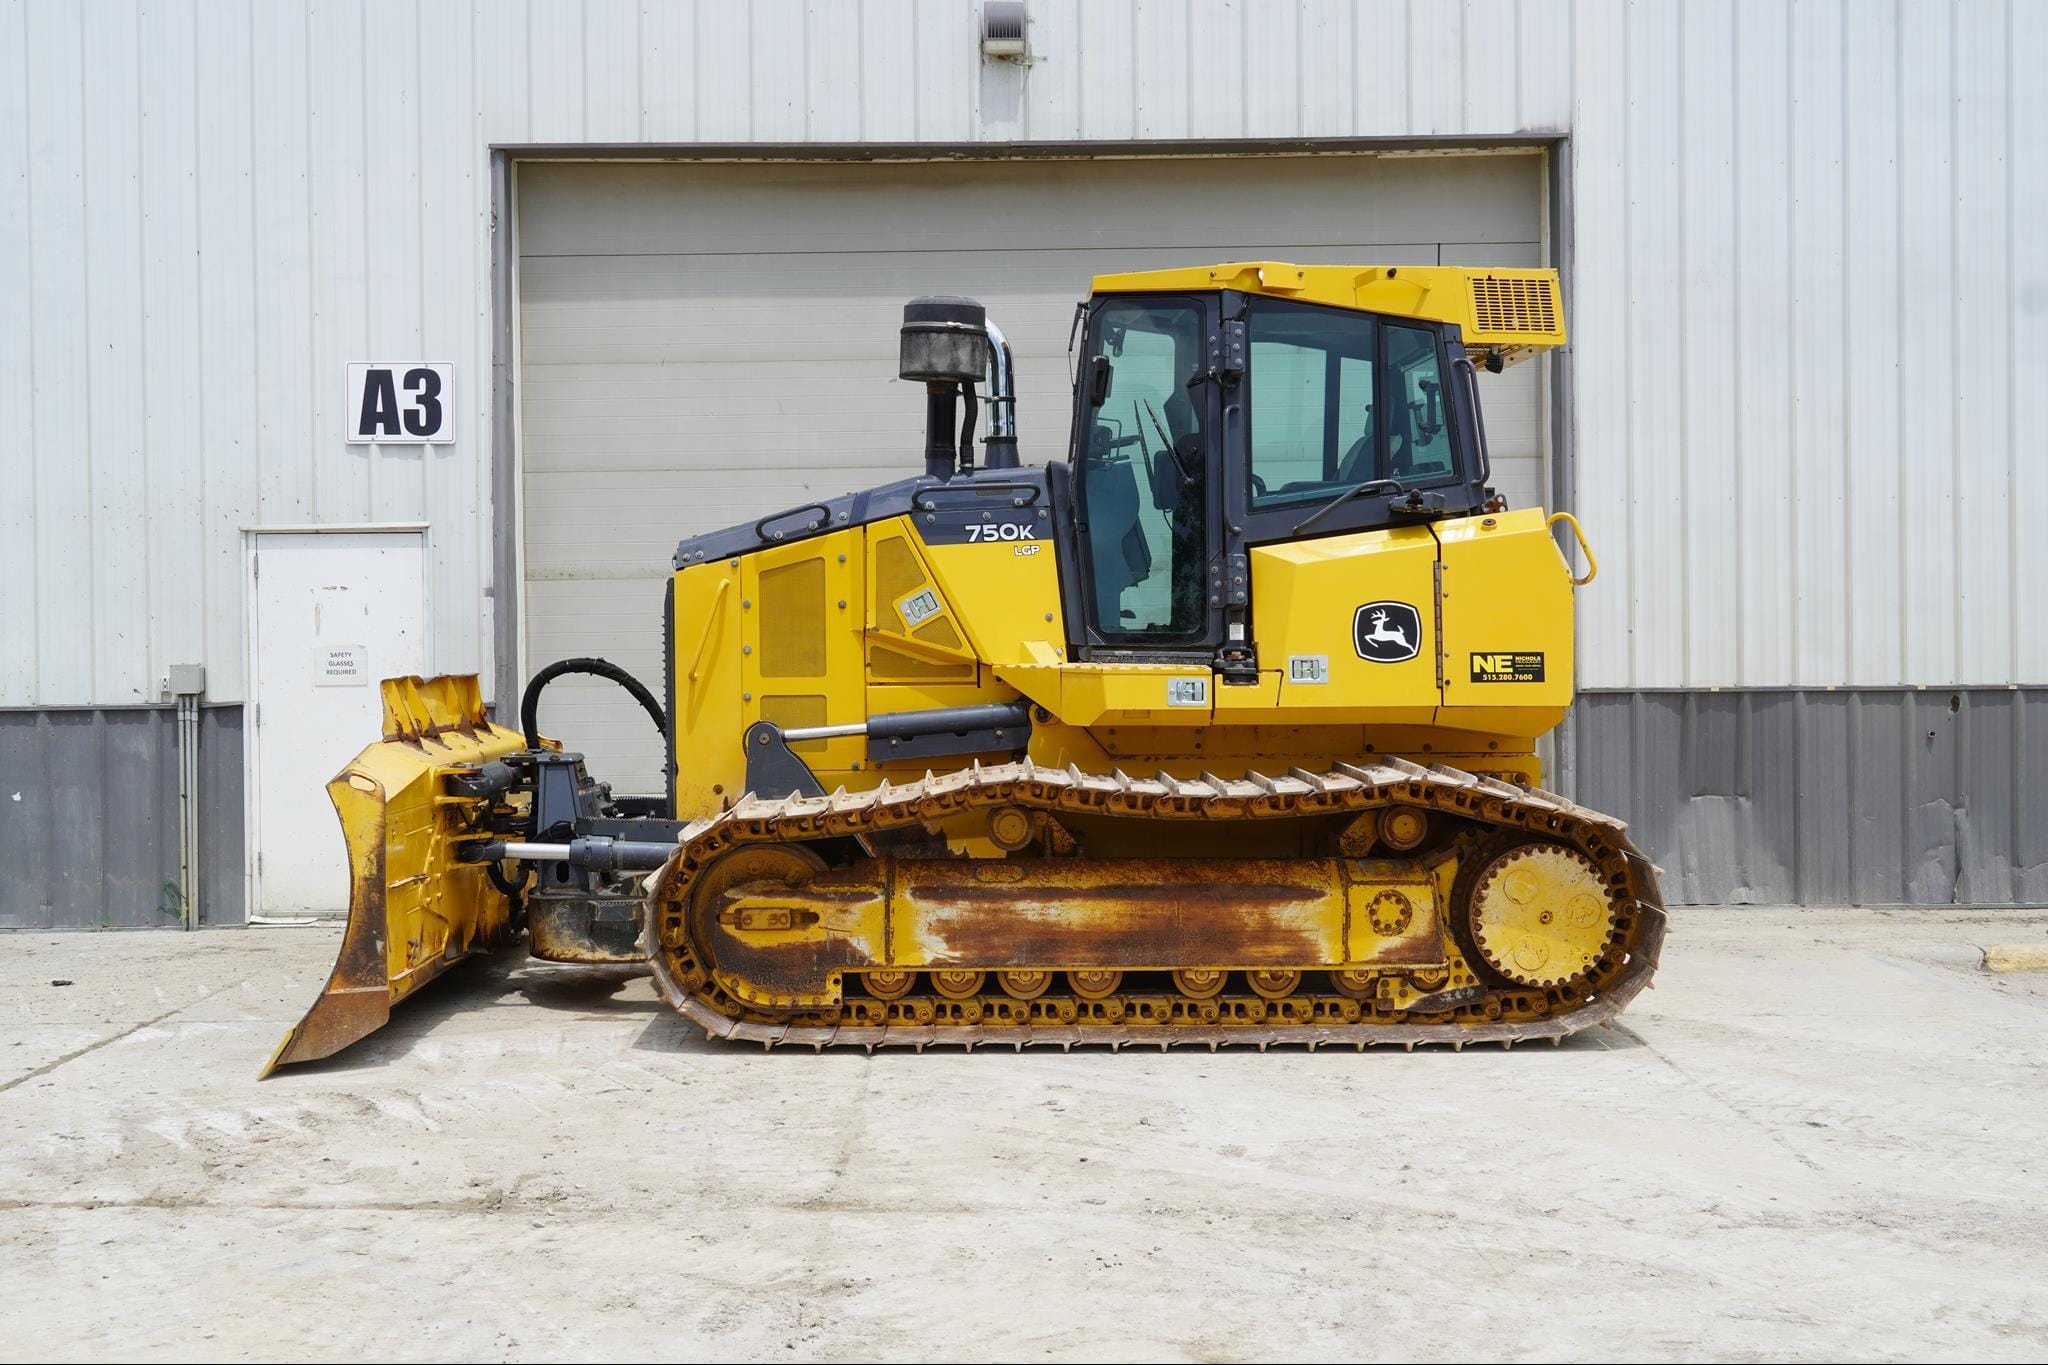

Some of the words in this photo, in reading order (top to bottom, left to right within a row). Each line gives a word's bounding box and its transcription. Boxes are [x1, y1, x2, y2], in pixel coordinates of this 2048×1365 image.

[359, 368, 442, 437] A3
[965, 523, 1036, 543] 750K
[1014, 545, 1040, 556] LGP
[1473, 655, 1513, 673] NE
